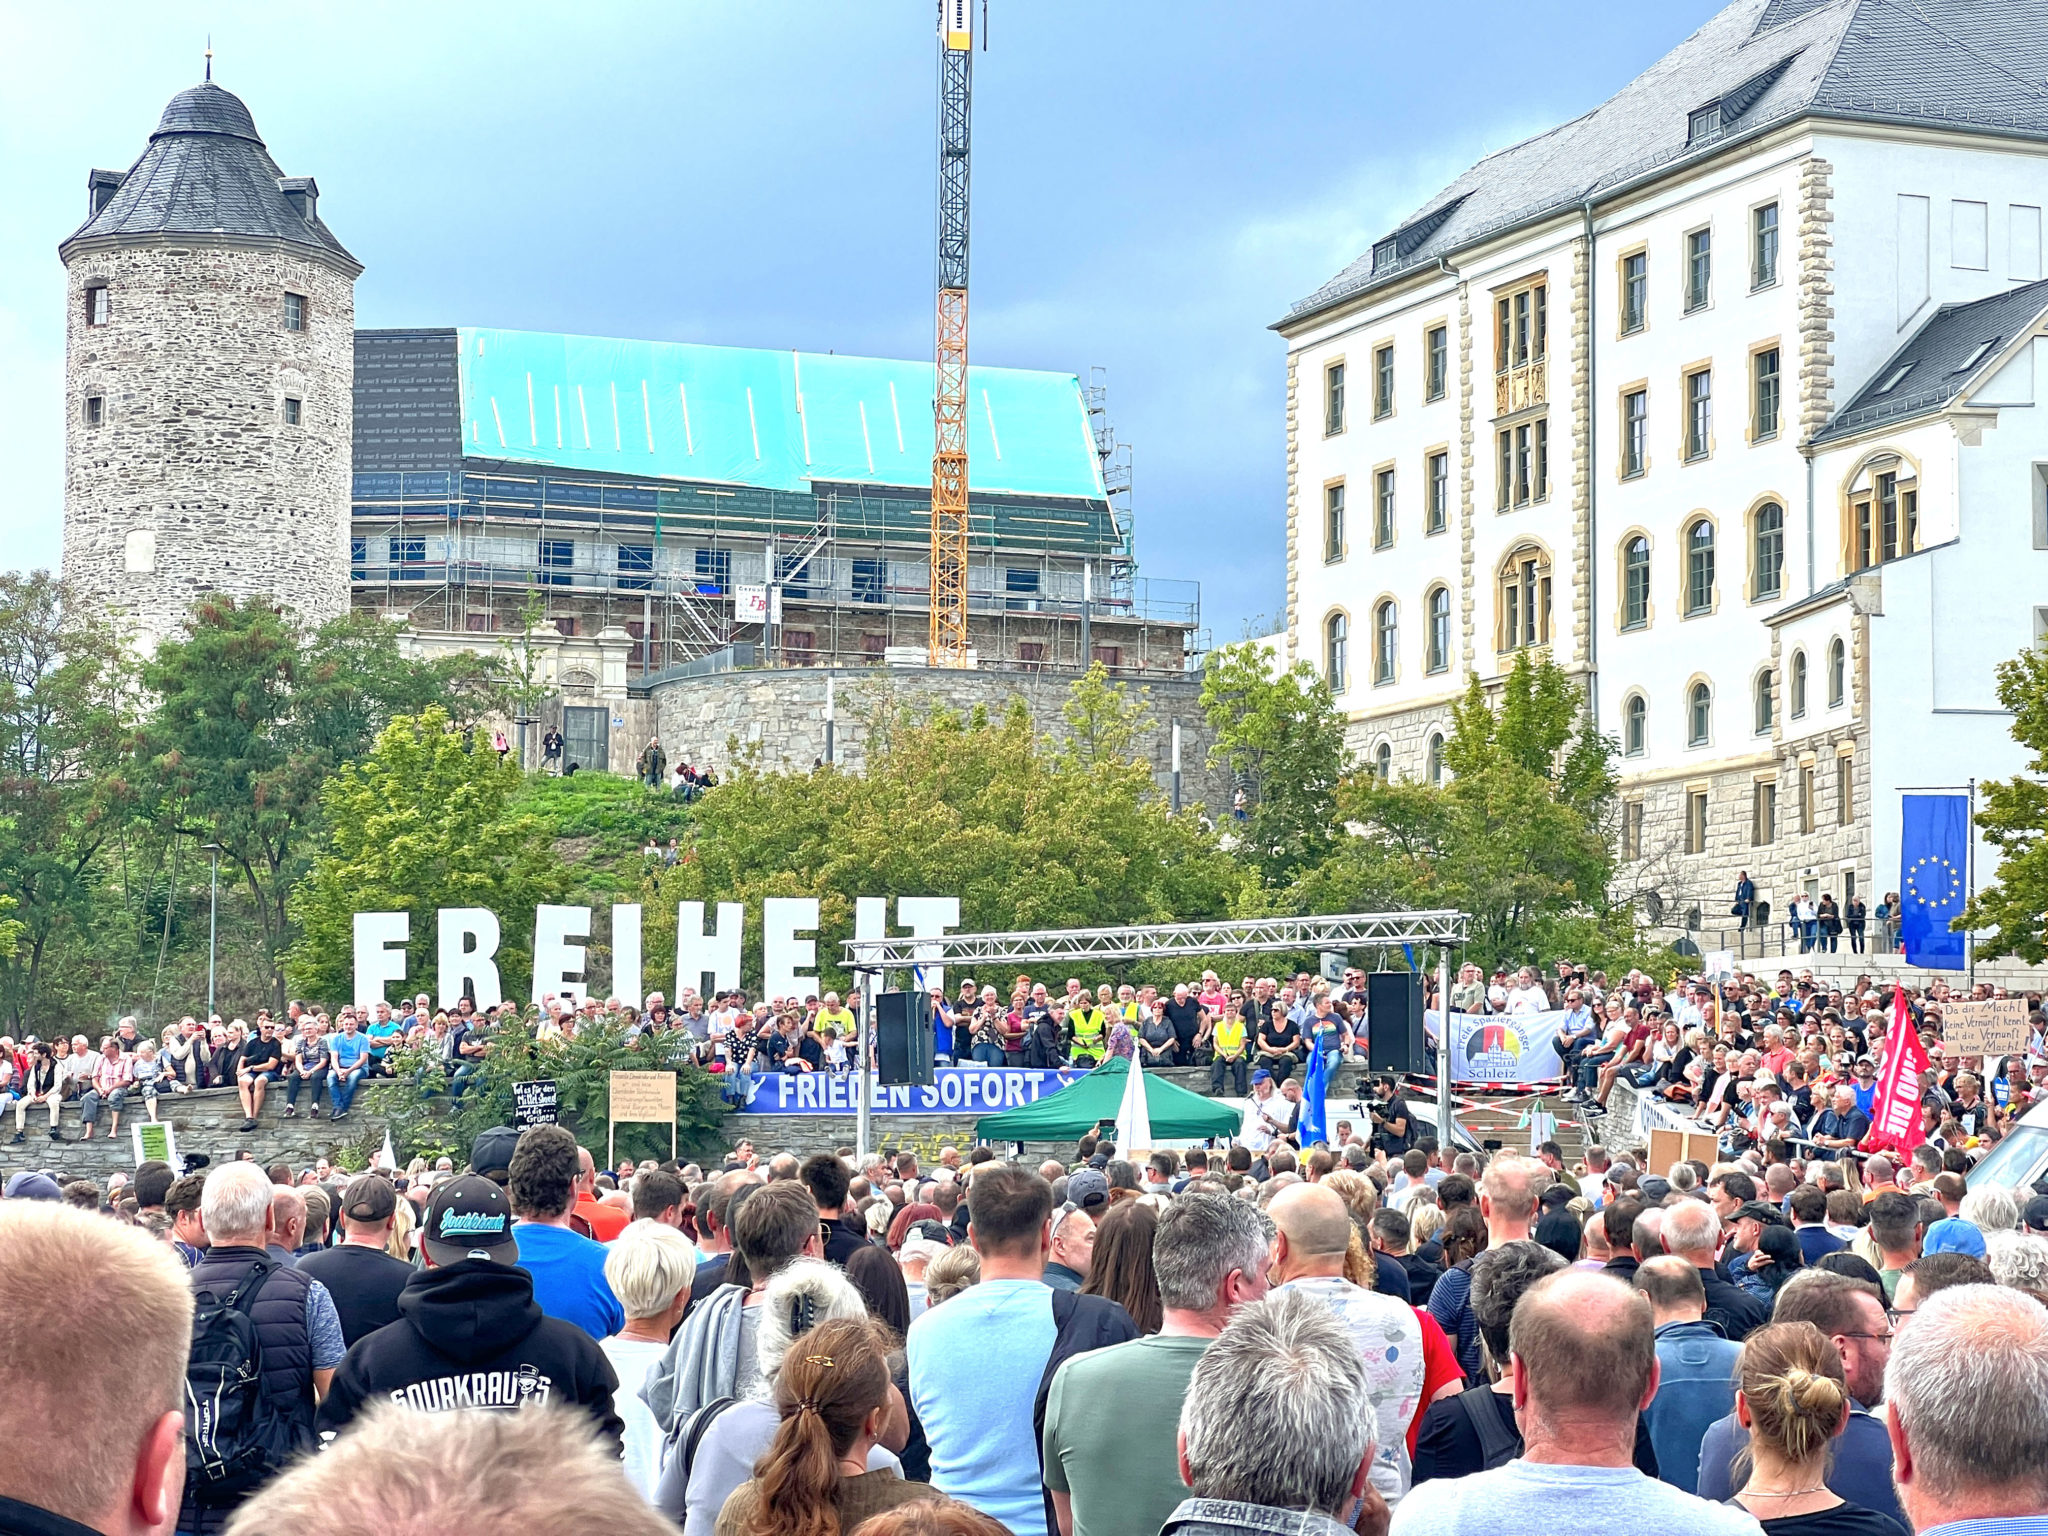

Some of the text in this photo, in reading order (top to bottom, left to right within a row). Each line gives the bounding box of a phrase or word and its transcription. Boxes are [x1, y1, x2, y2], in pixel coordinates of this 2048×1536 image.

[353, 897, 960, 1013] FREIHEIT
[1946, 1005, 1958, 1014] Da
[1962, 1004, 1975, 1013] die
[1473, 1017, 1530, 1051] Spaziergänger
[1962, 1032, 1975, 1040] die
[1468, 1069, 1516, 1078] Schleiz
[921, 1072, 1044, 1108] SOFORT
[527, 1114, 554, 1122] Grünen
[1886, 1100, 1914, 1139] DIE
[1203, 1504, 1248, 1520] GREEN
